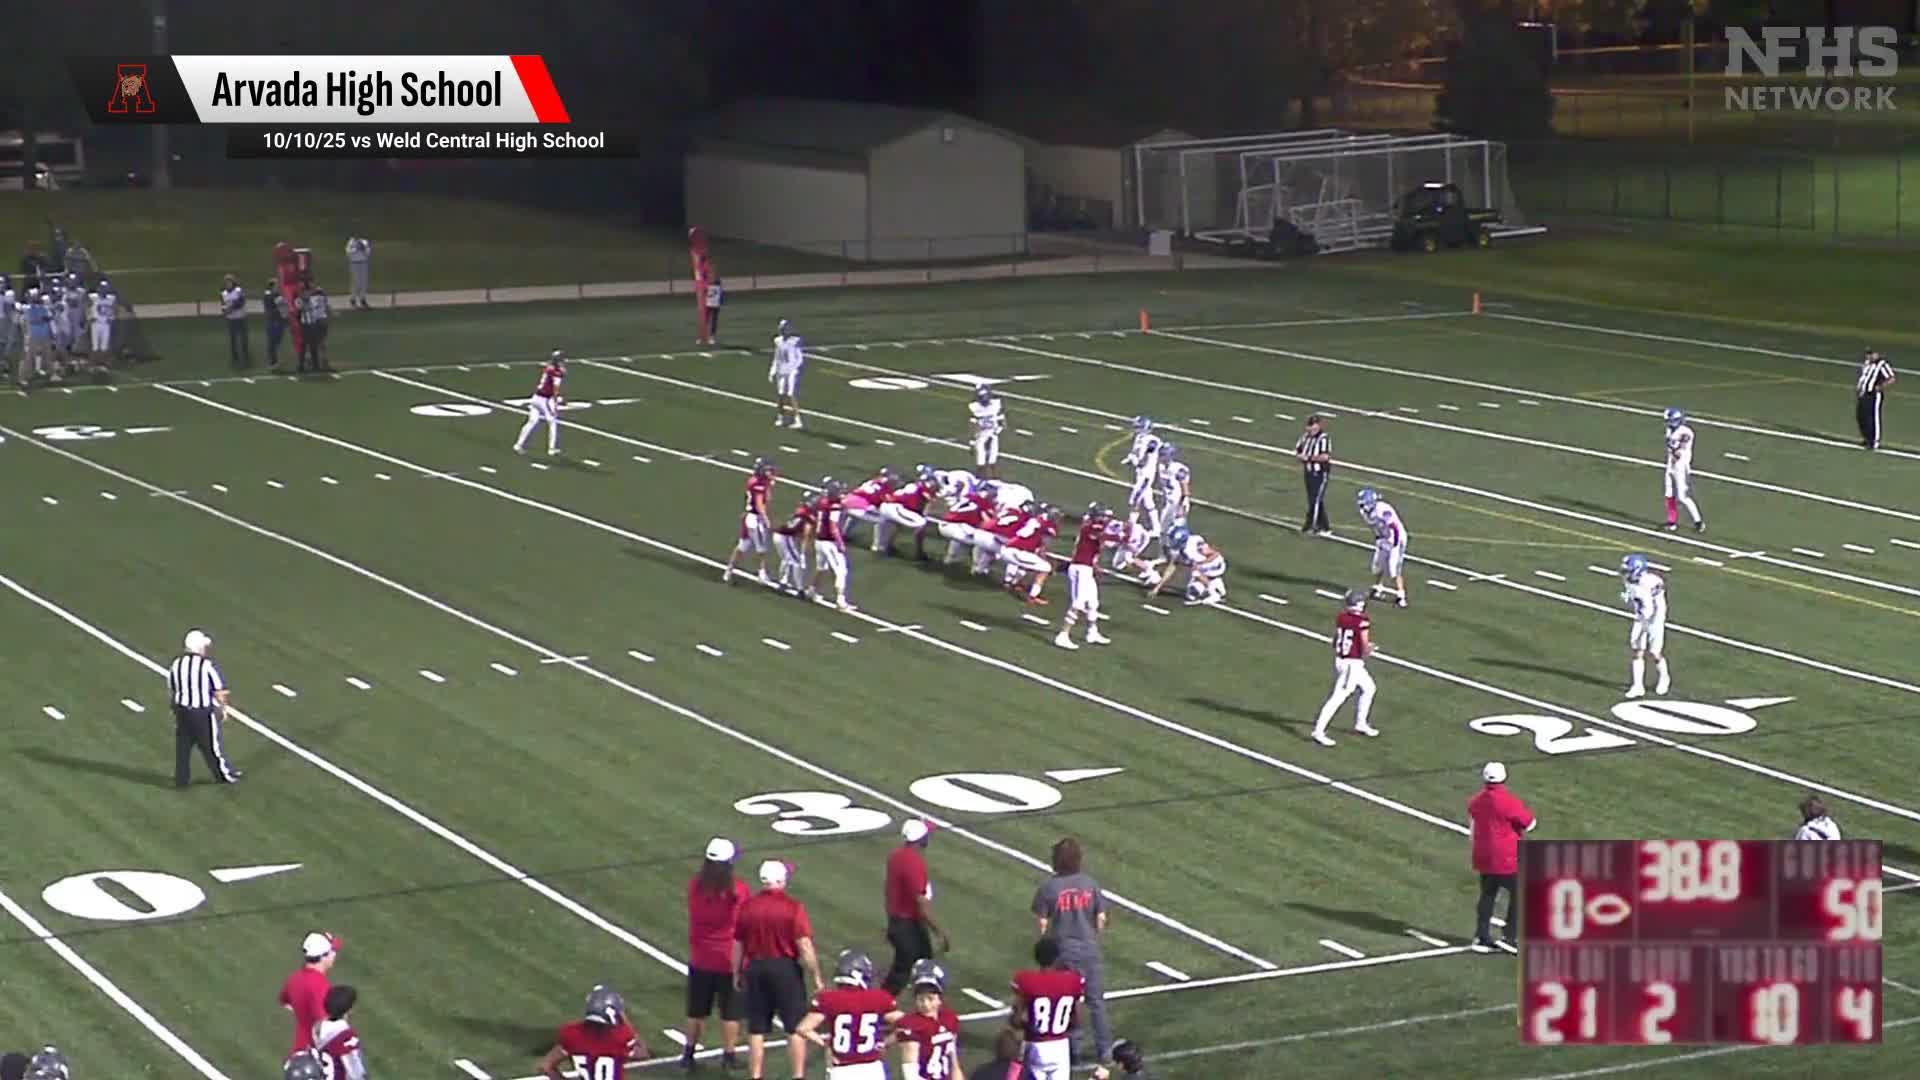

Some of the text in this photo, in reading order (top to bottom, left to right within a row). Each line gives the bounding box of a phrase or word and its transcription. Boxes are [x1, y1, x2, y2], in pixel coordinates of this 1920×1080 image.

[1469, 701, 1758, 755] 20
[733, 772, 1063, 836] 30
[833, 1013, 878, 1053] 65
[1033, 996, 1074, 1034] 80
